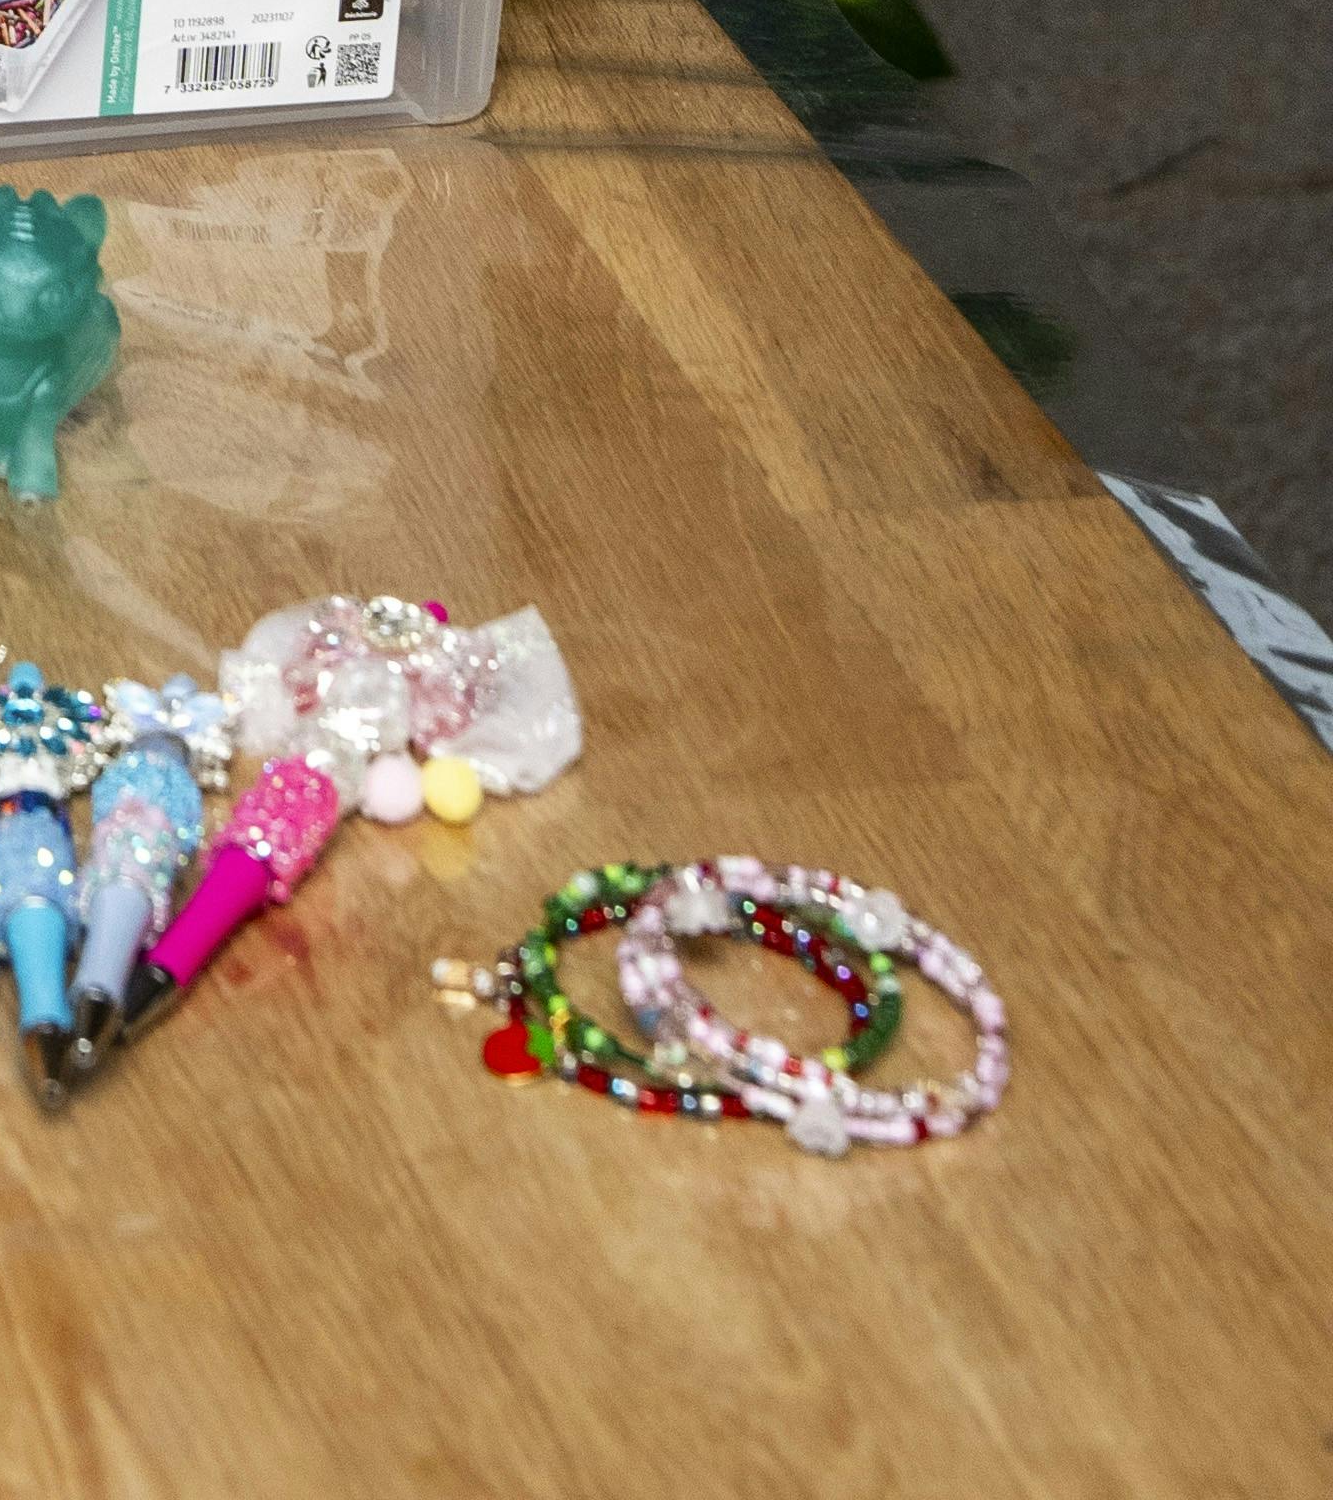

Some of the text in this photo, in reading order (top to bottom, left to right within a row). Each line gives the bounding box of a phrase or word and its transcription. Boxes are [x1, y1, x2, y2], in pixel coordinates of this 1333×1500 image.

[109, 65, 120, 76] by
[107, 78, 117, 103] Made
[163, 77, 276, 94] 7 332462 058729
